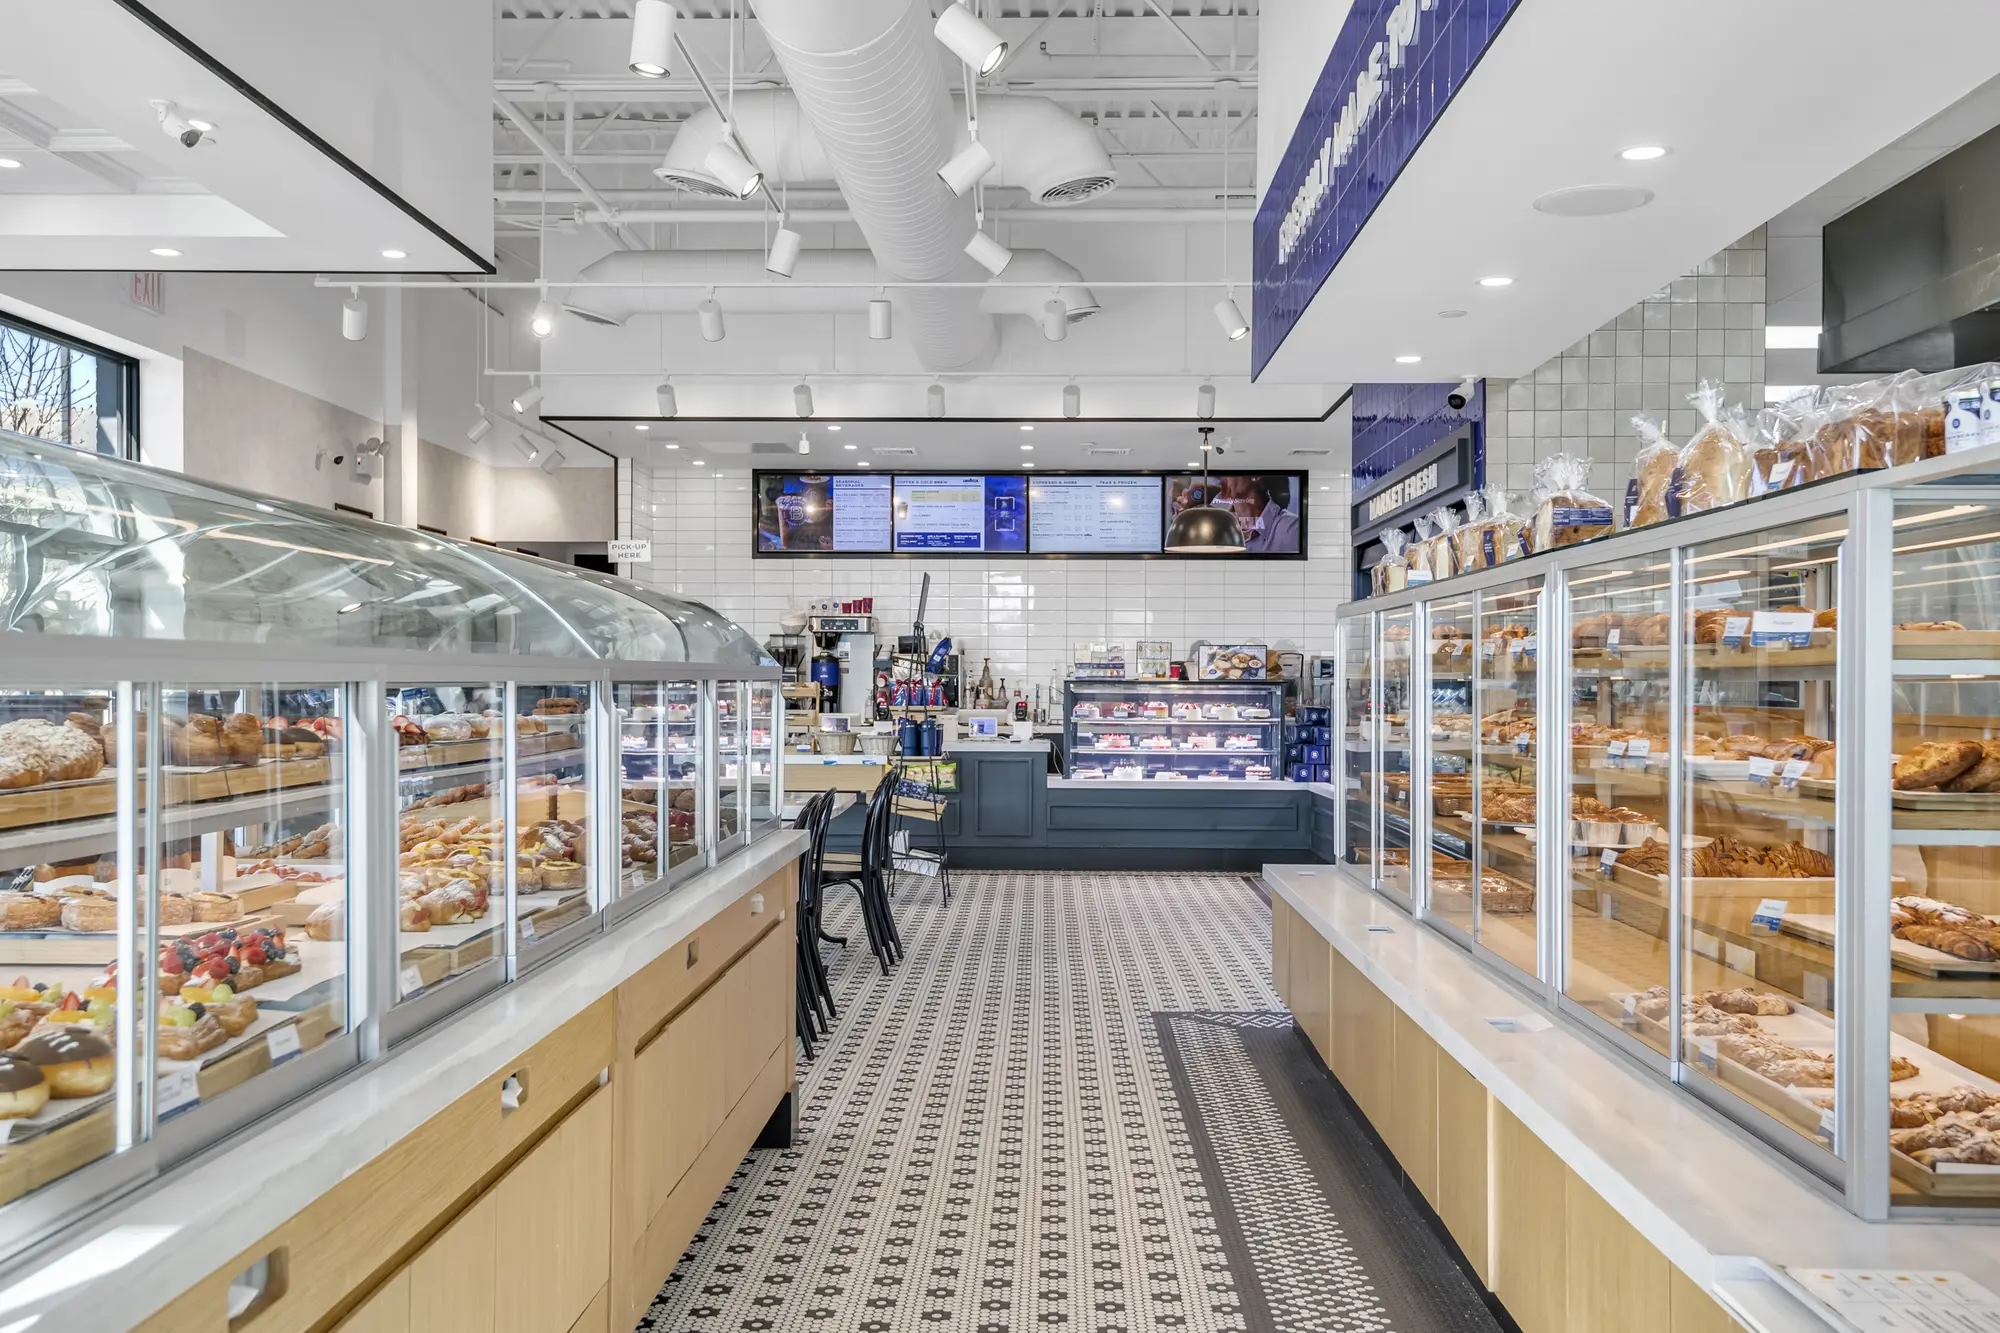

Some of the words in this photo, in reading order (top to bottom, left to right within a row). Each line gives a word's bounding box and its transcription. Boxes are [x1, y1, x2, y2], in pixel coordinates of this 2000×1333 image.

[134, 272, 163, 308] EXIT
[1212, 497, 1234, 505] Proudly
[1369, 483, 1404, 521] MARKET
[1405, 463, 1438, 503] FRESH
